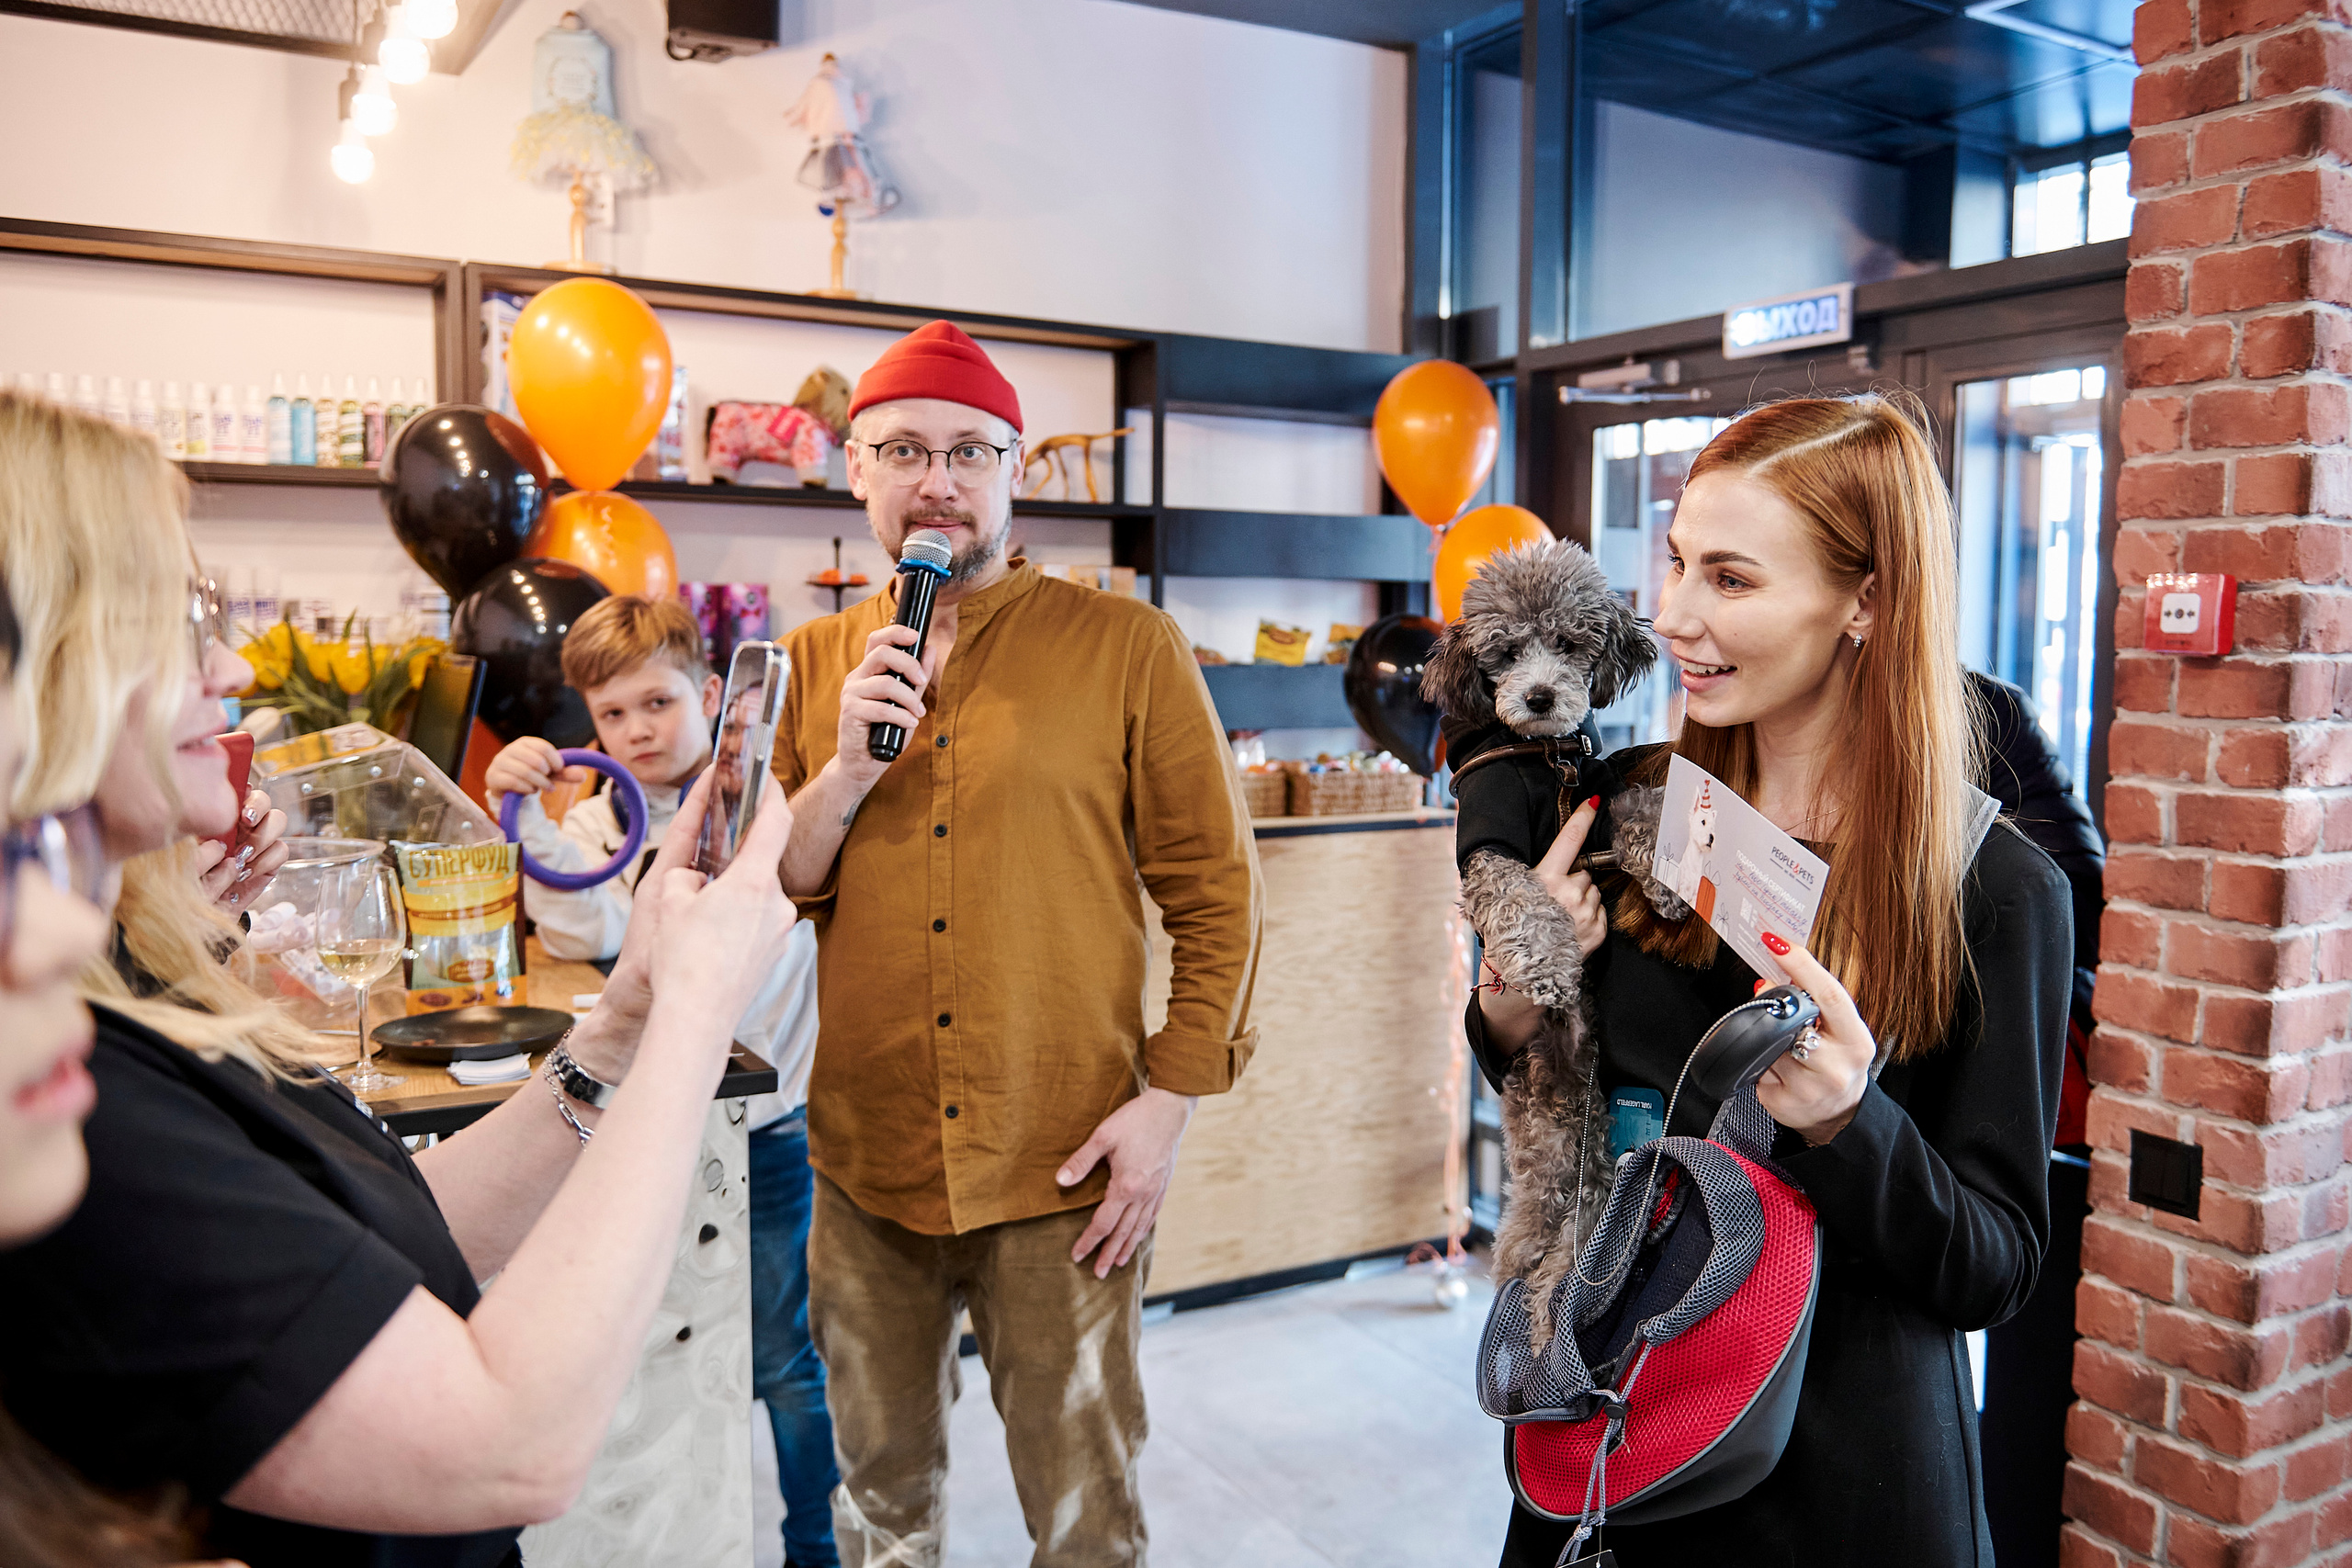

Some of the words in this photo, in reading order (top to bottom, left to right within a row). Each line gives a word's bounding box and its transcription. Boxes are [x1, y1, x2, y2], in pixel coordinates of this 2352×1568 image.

[409, 845, 509, 878] СУПЕРФУД
[1736, 850, 1770, 884] ПОДАРОЧНЫЙ
[1768, 878, 1806, 912] СЕРТИФИКАТ
[1617, 1099, 1640, 1108] LAGERFELD
